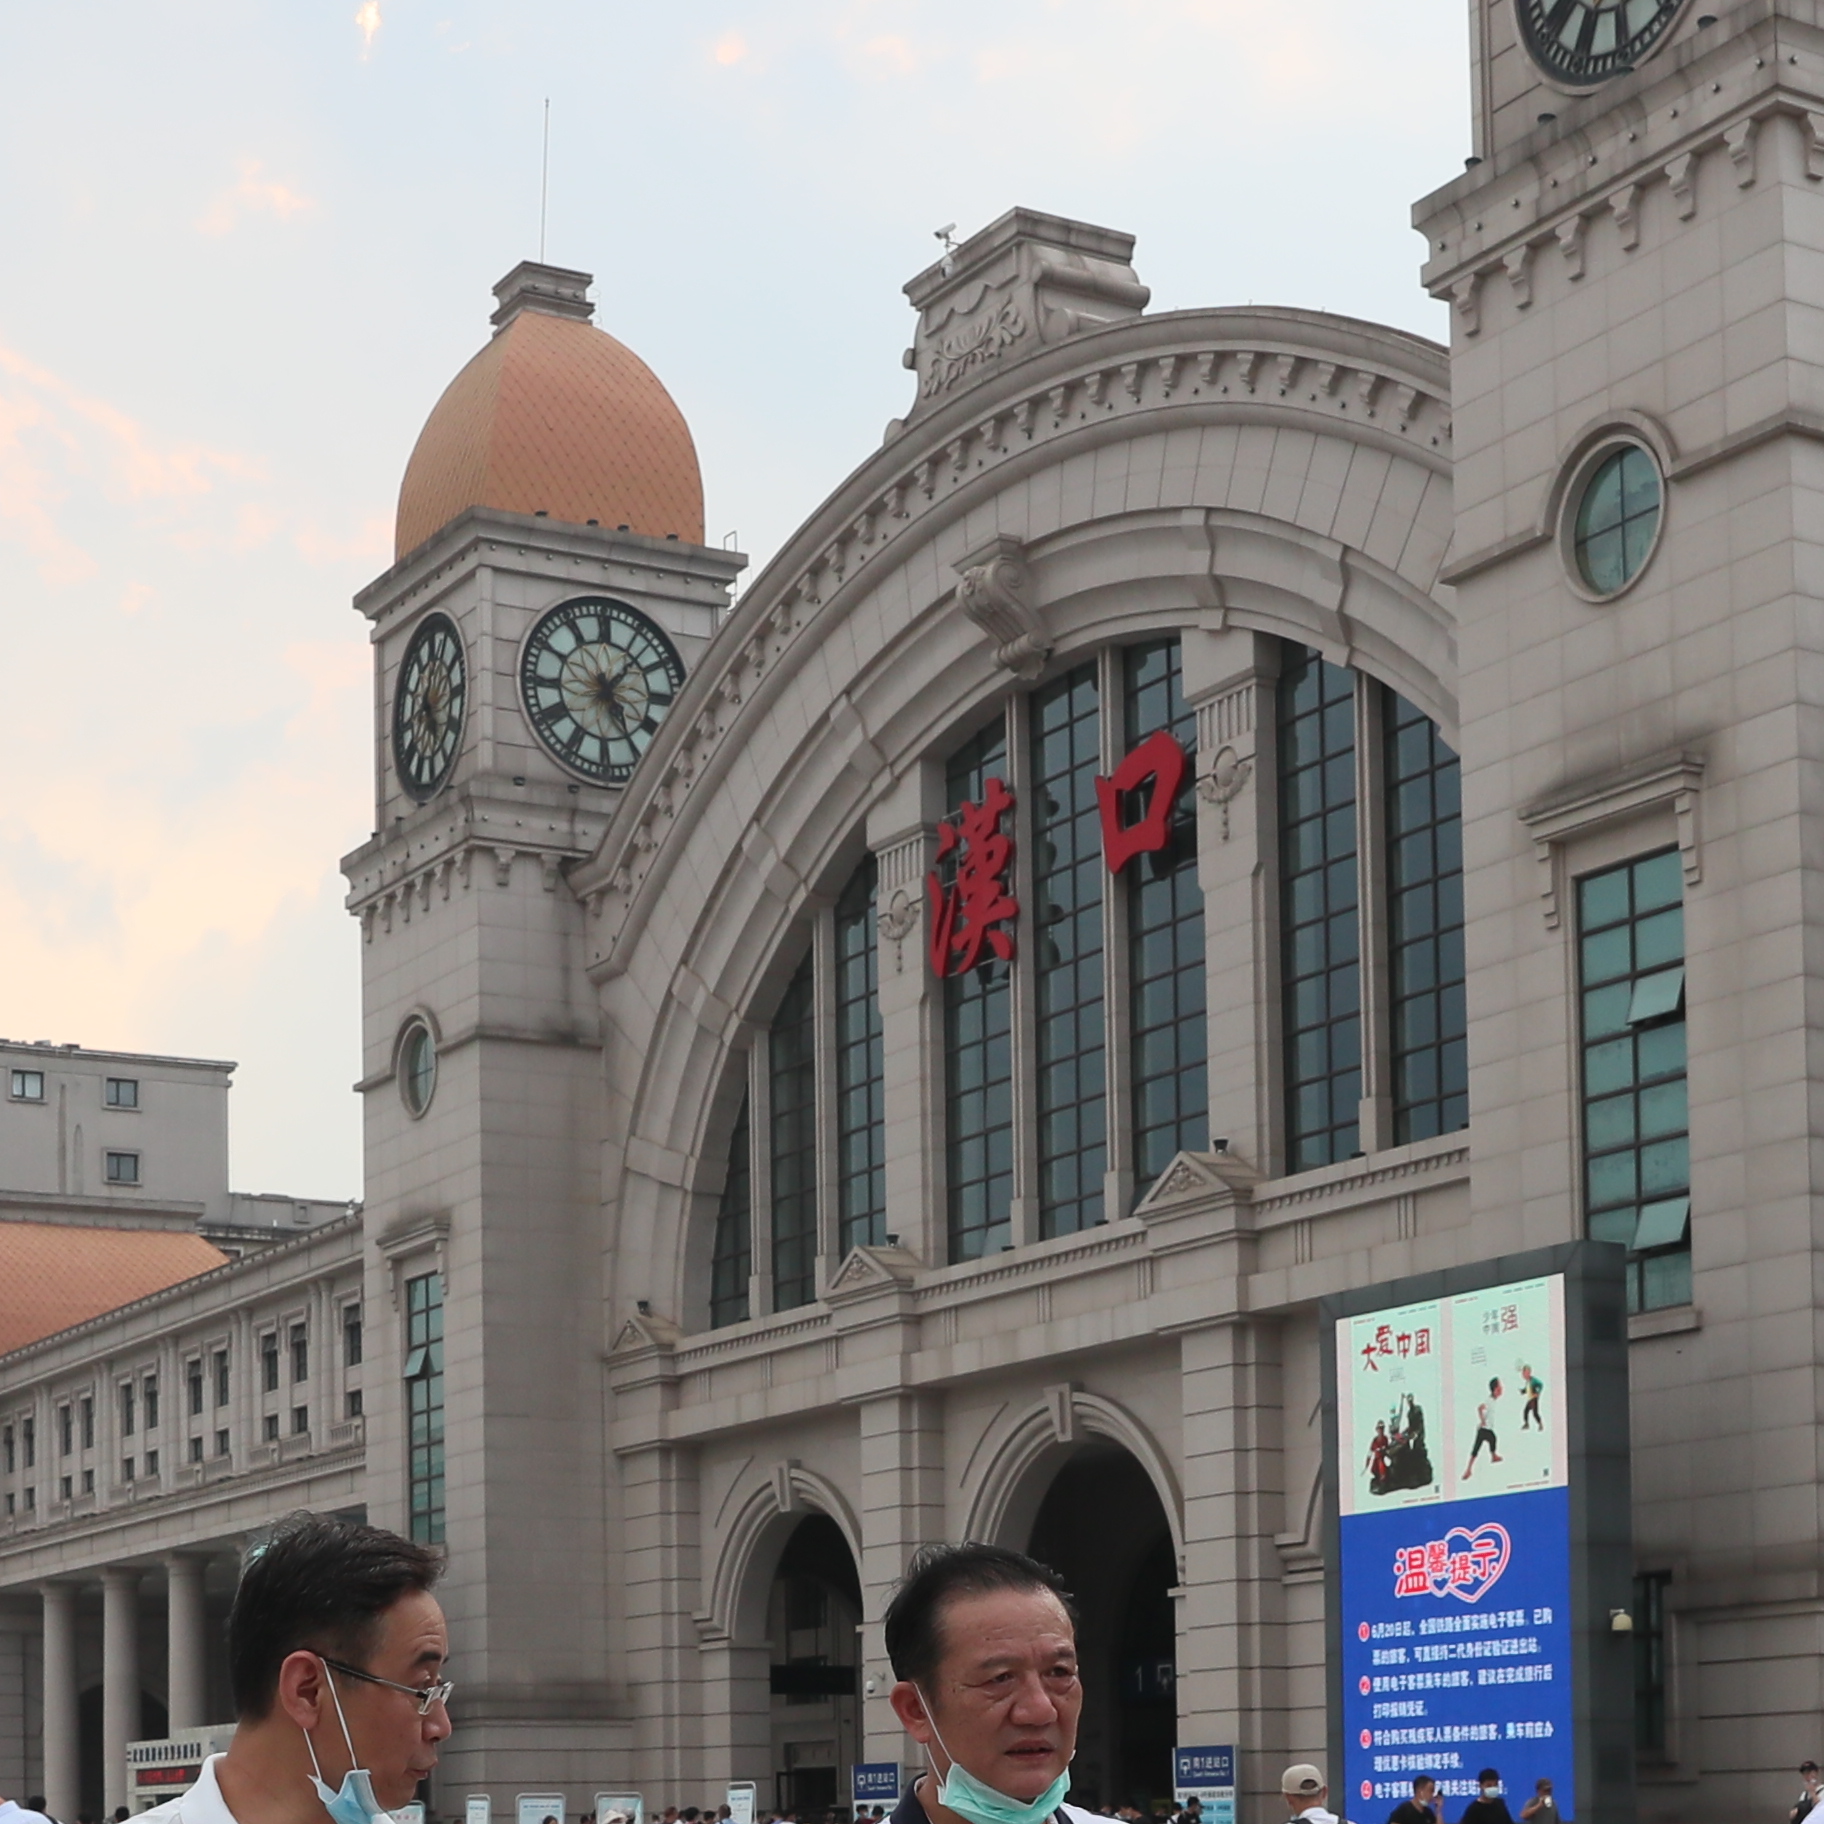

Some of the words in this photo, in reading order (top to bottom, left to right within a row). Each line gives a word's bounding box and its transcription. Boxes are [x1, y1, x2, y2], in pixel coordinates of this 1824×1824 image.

[928, 730, 1184, 979] 漢口
[1361, 1324, 1431, 1372] 大爱中国
[1393, 1537, 1500, 1599] 温馨提示
